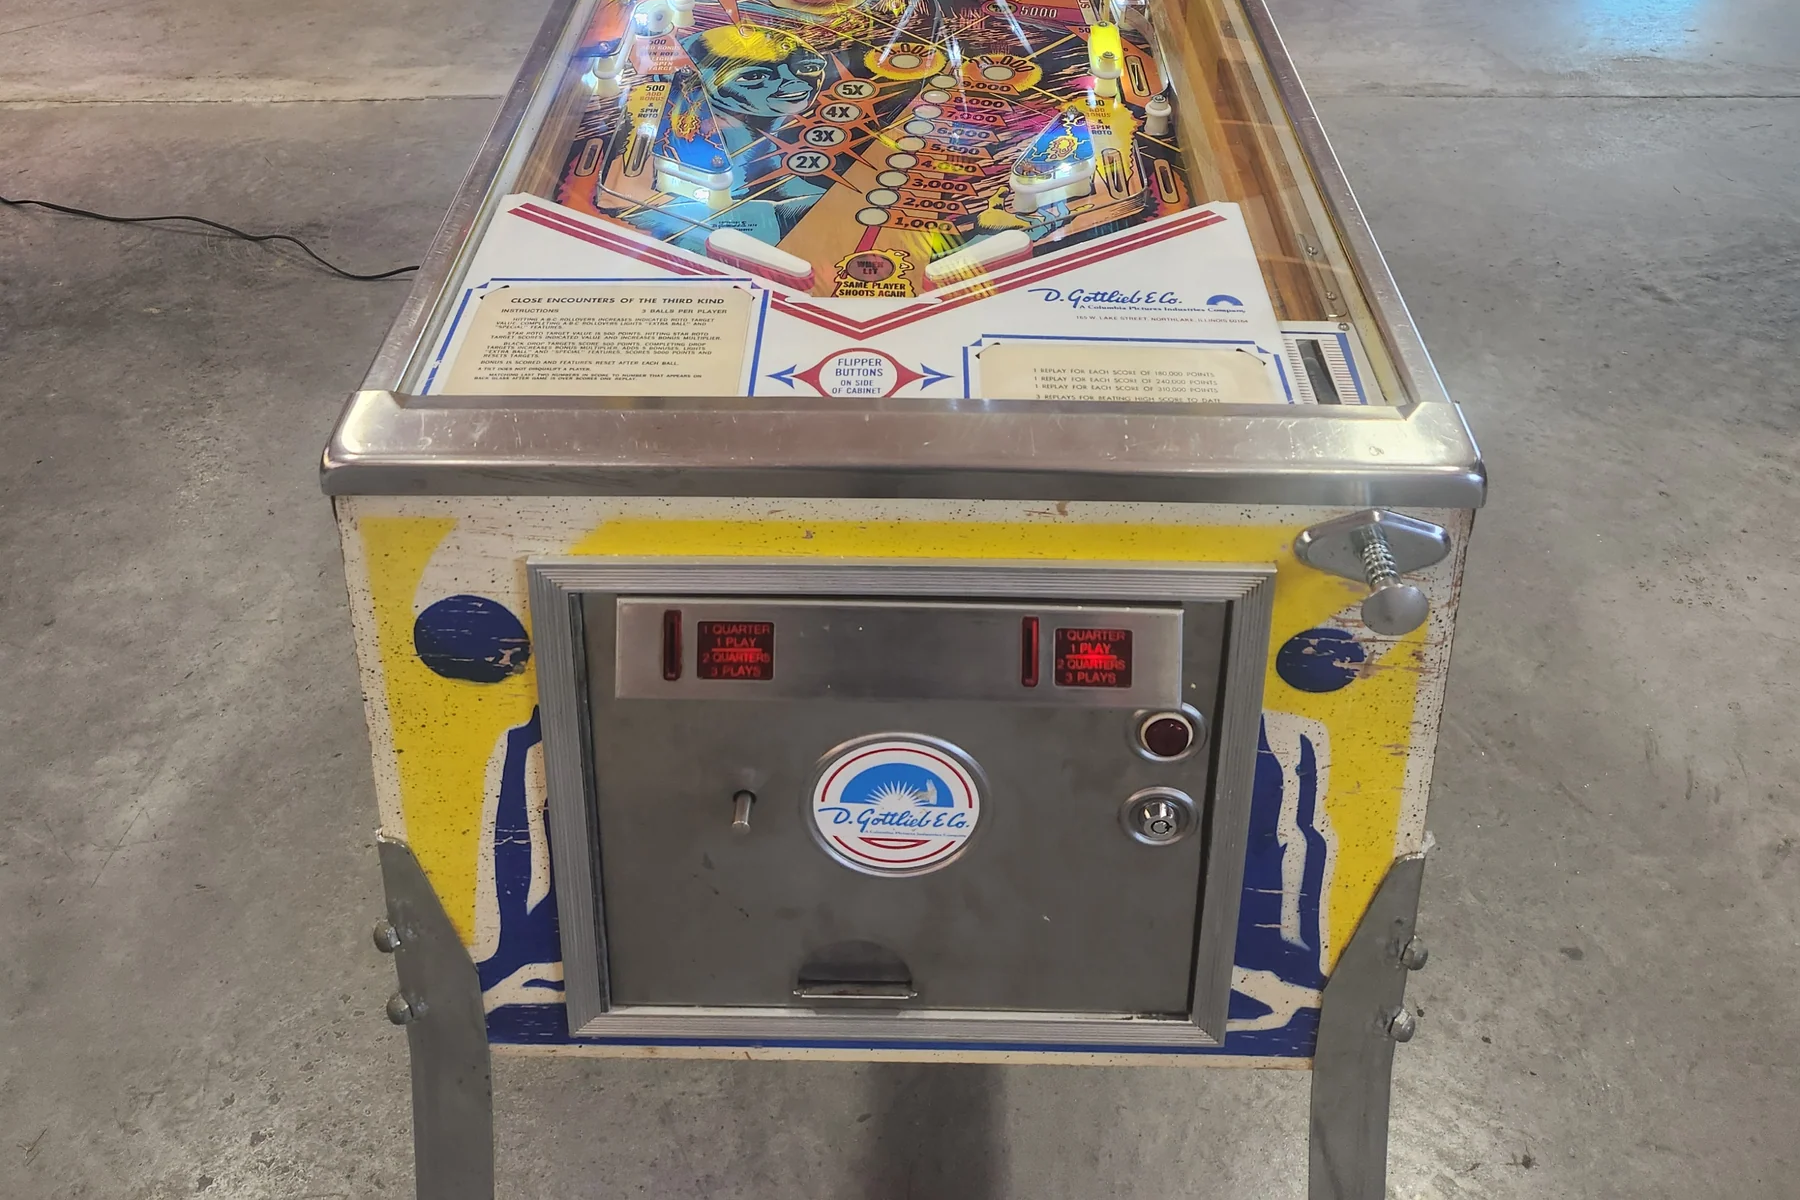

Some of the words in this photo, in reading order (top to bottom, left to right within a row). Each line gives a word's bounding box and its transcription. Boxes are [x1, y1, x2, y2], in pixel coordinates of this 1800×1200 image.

[1019, 7, 1058, 19] 5000
[645, 84, 665, 92] 500
[842, 84, 865, 96] 5X
[962, 80, 1011, 92] 9,000
[825, 106, 849, 119] 4X
[811, 130, 834, 143] 3X
[795, 156, 821, 169] 2X
[912, 179, 968, 192] 3,000
[903, 197, 960, 212] 2,000
[894, 216, 953, 231] 1,000
[872, 282, 906, 290] PLAYER
[838, 289, 875, 297] SHOOTS
[878, 289, 906, 297] AGAIN
[1028, 288, 1064, 302] D.
[1067, 288, 1143, 308] Gottlieb
[1158, 291, 1182, 305] Co.
[837, 358, 882, 367] FLIPPER
[835, 368, 883, 377] BUTTONS
[712, 624, 770, 635] QUARTER
[1066, 630, 1125, 641] QUARTER
[726, 637, 756, 647] PLAY
[1080, 642, 1111, 653] PLAY
[712, 651, 770, 663] QUARTERS
[1066, 658, 1126, 671] QUARTERS
[722, 665, 761, 677] PLAYS
[1077, 671, 1117, 684] PLAYS
[818, 807, 853, 824] D.
[856, 808, 932, 833] Gottlieb
[947, 812, 970, 828] Co.
